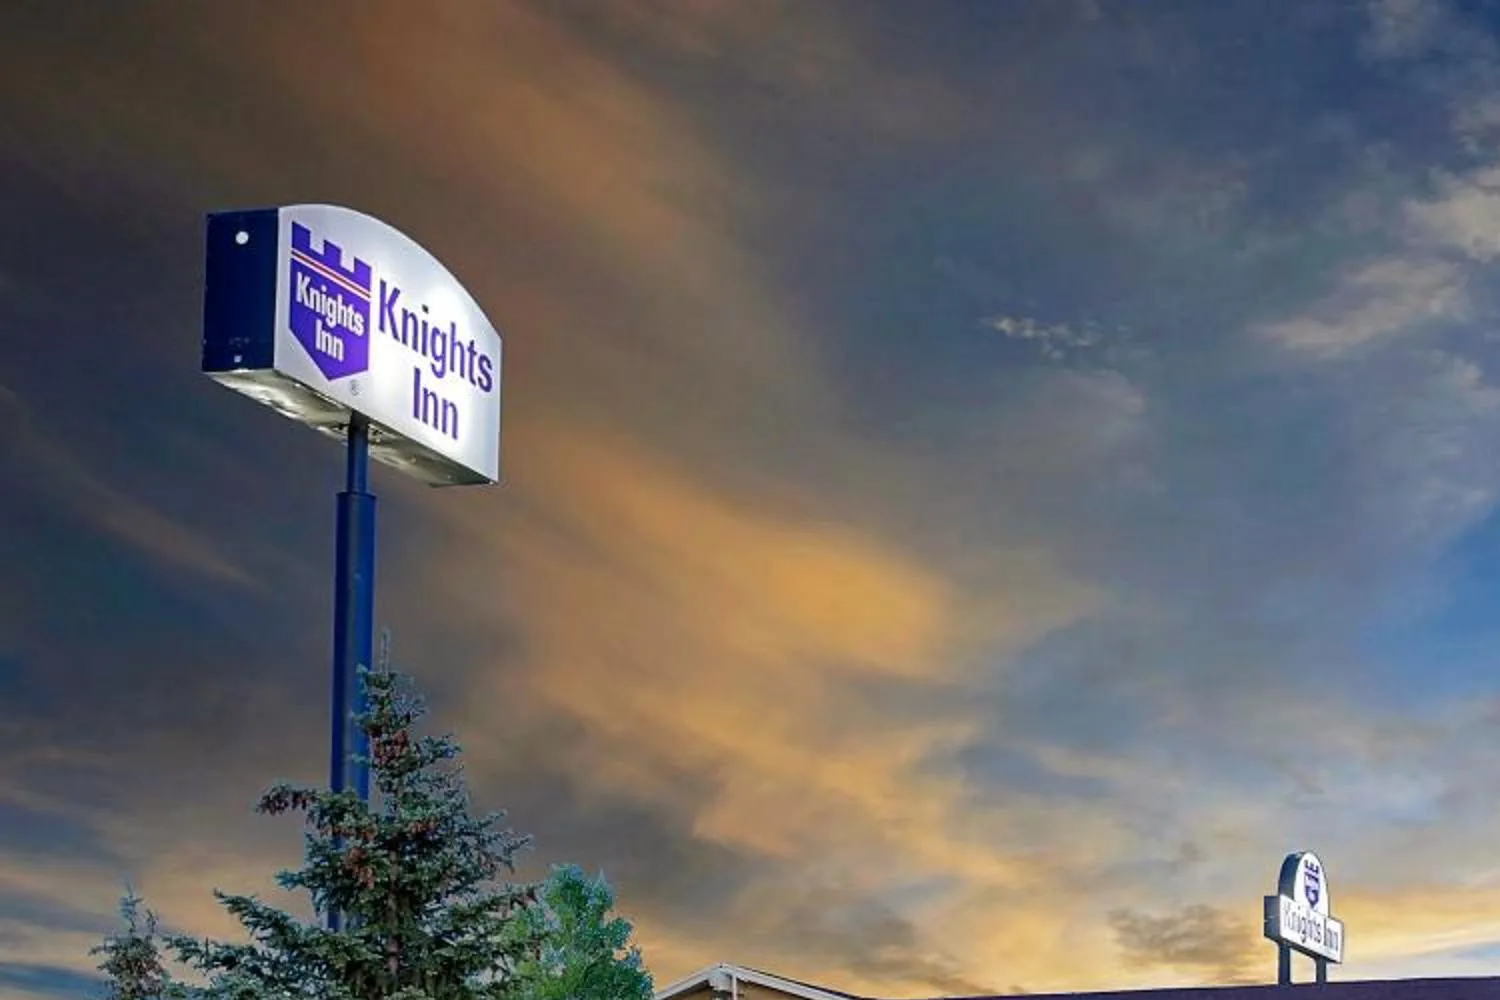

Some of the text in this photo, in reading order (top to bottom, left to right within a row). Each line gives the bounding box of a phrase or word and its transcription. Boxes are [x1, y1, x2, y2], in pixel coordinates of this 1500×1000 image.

[296, 271, 365, 337] Knights
[378, 279, 493, 393] Knights
[315, 319, 345, 362] Inn
[412, 367, 459, 440] Inn
